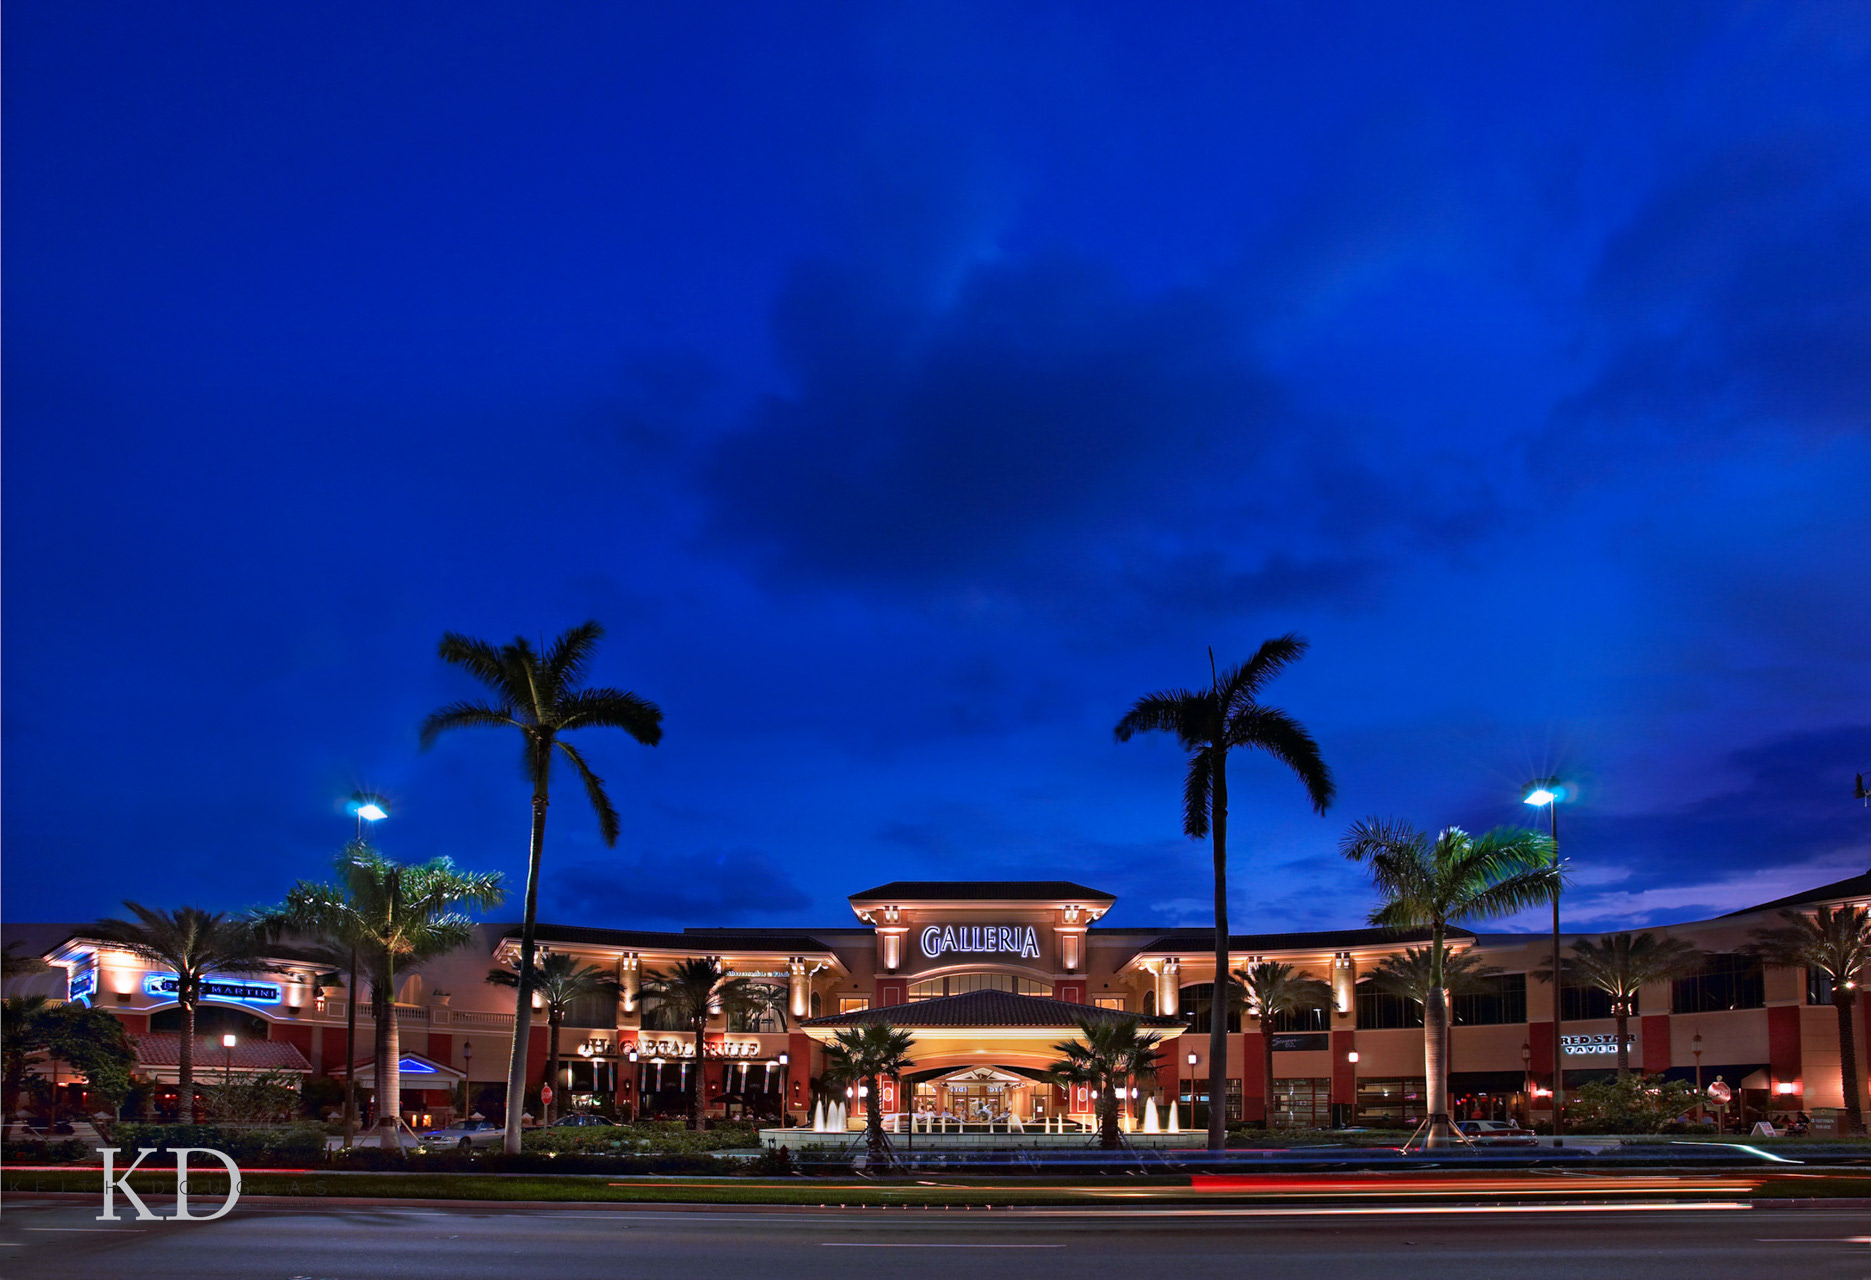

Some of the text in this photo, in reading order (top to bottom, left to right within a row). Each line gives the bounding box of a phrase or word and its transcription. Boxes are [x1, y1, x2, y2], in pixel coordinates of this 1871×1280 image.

[921, 925, 1040, 958] GALLERIA
[211, 985, 275, 998] MARTINI
[1561, 1034, 1591, 1047] RED
[1564, 1044, 1632, 1055] TAVER
